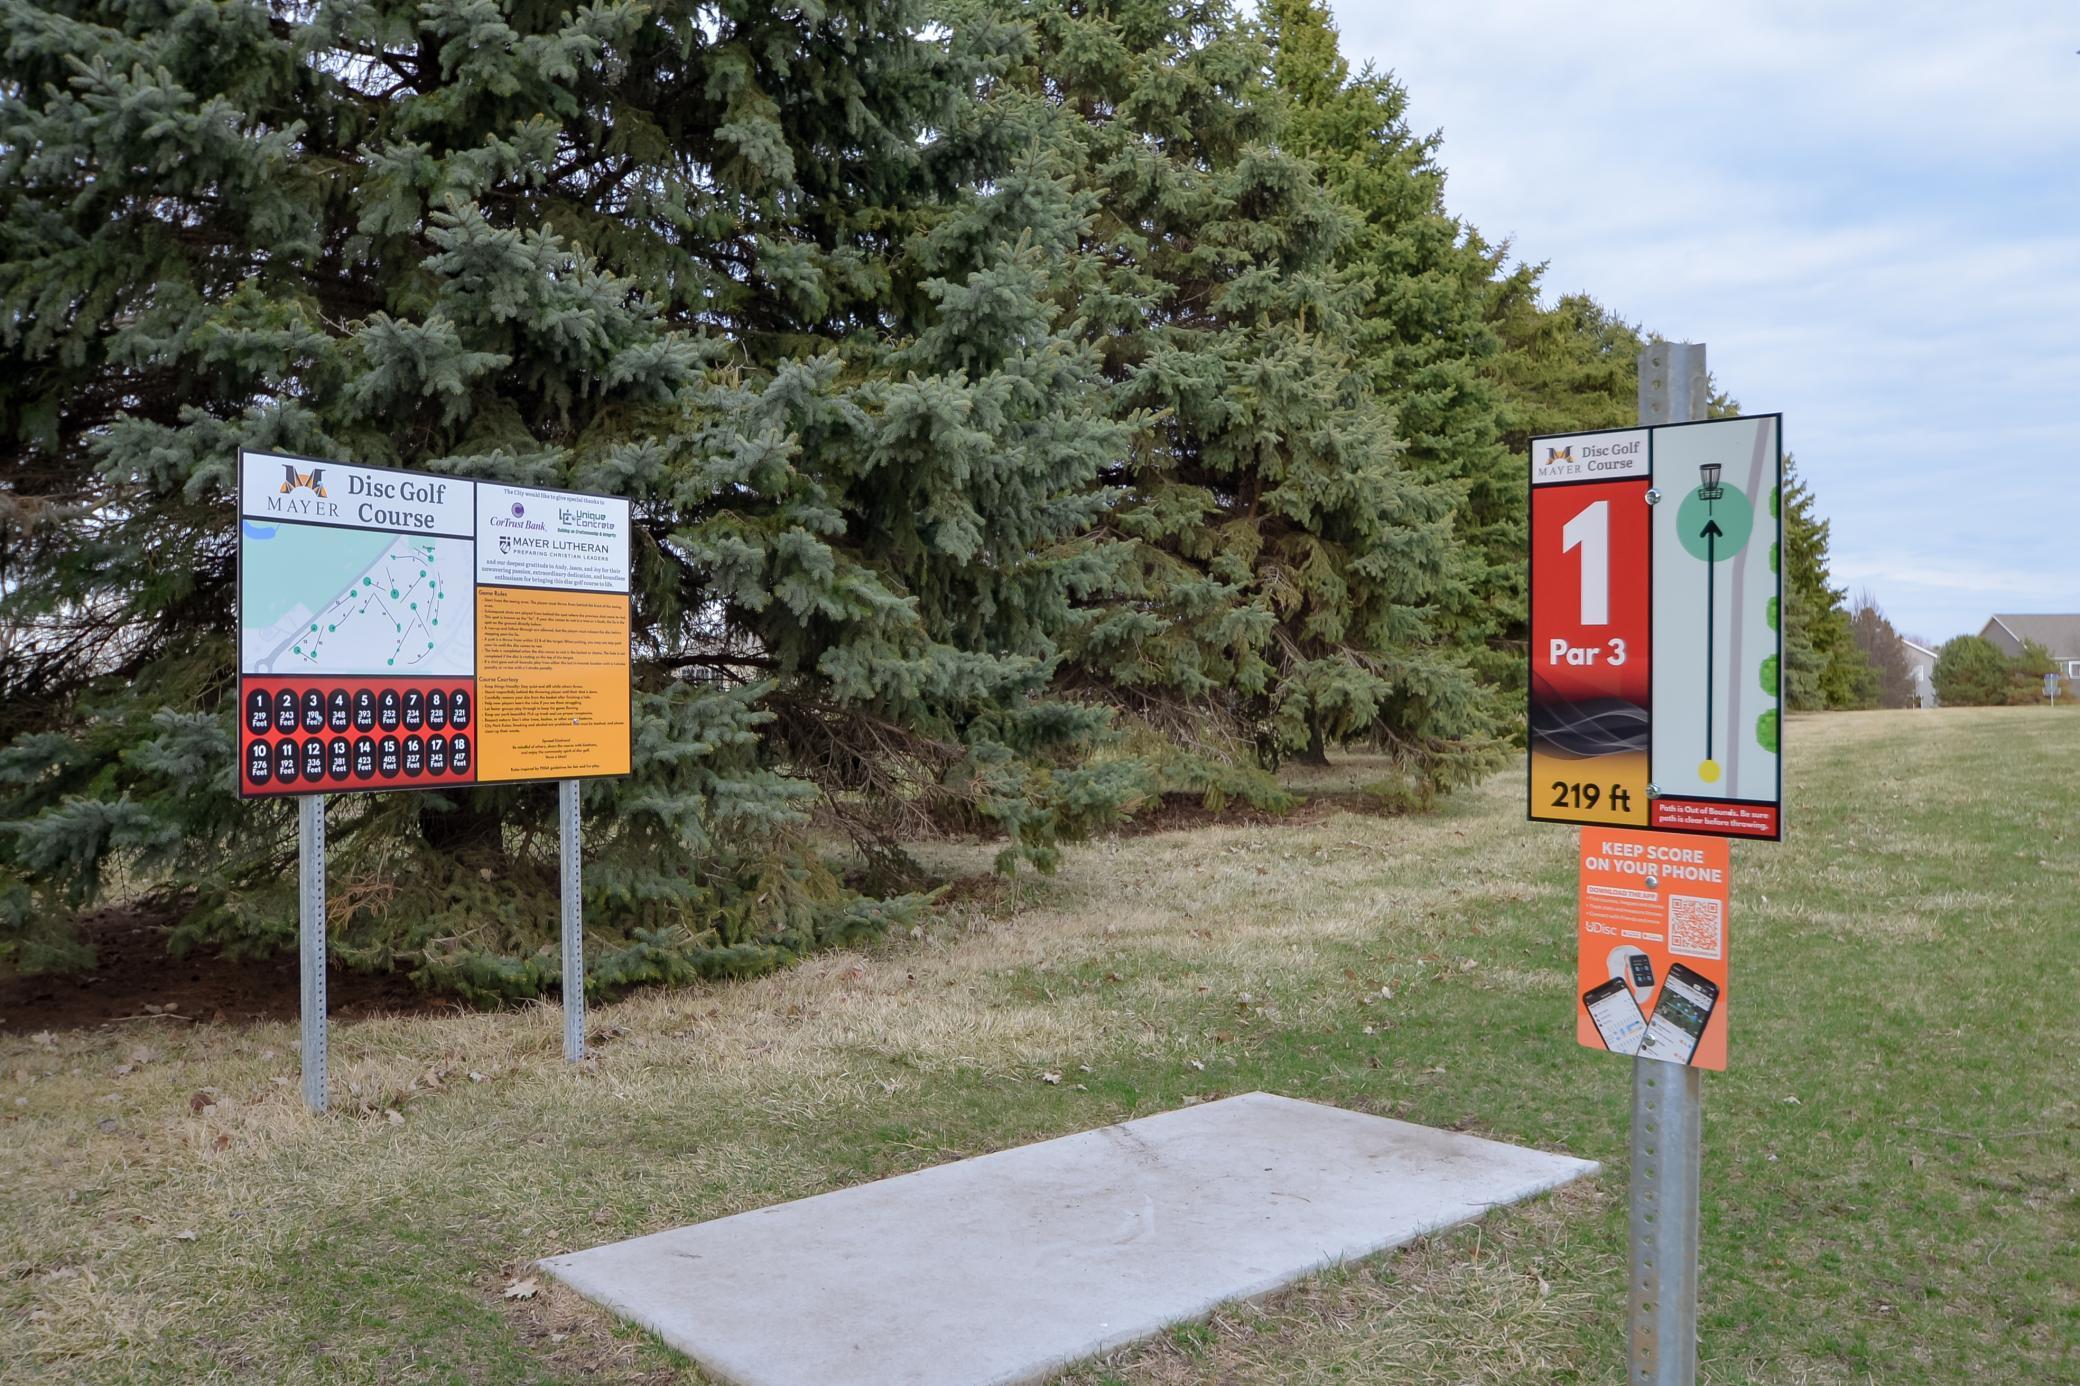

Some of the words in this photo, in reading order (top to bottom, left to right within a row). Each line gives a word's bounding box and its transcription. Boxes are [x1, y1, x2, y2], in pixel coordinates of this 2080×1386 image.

[1582, 446, 1609, 458] Disc
[1611, 441, 1640, 456] Golf
[1538, 464, 1582, 476] MAYER
[1587, 458, 1633, 472] Course
[348, 474, 396, 498] Disc
[400, 481, 446, 504] Golf
[514, 489, 524, 497] City
[267, 496, 340, 517] MAYER
[358, 502, 435, 529] Course
[576, 509, 606, 521] Unique
[490, 516, 524, 529] CorTrust
[525, 519, 545, 531] Bank
[576, 519, 615, 530] Concrete
[513, 537, 550, 549] MAYER
[552, 540, 609, 554] LUTHERAN
[513, 549, 548, 557] PREPARING
[549, 552, 582, 560] CHRISTIAN
[1562, 500, 1609, 626] 1
[1549, 638, 1600, 666] Par
[1607, 638, 1626, 666] 3
[256, 694, 262, 707] 1
[282, 694, 292, 707] 2
[309, 694, 318, 707] 3
[334, 694, 344, 707] 4
[360, 694, 369, 706] 5
[385, 694, 393, 706] 6
[409, 694, 418, 706] 7
[432, 694, 441, 706] 8
[455, 694, 464, 706] 9
[253, 711, 267, 720] 219
[280, 710, 295, 719] 243
[307, 710, 320, 718] 198
[332, 710, 346, 719] 348
[358, 709, 371, 718] 393
[382, 709, 396, 718] 252
[406, 709, 420, 717] 234
[453, 708, 466, 717] 321
[252, 719, 268, 727] Feet
[279, 718, 295, 726] Feet
[332, 718, 347, 726] Feet
[357, 717, 372, 725] Feet
[406, 716, 420, 724] Feet
[282, 743, 292, 756] 11
[307, 742, 321, 755] 12
[333, 742, 346, 754] 13
[358, 741, 371, 754] 14
[383, 740, 395, 753] 15
[407, 739, 419, 752] 16
[431, 739, 443, 751] 17
[454, 738, 466, 750] 18
[253, 744, 267, 757] 10
[454, 752, 466, 760] 417
[307, 758, 321, 767] 336
[332, 757, 346, 766] 381
[357, 756, 372, 764] 423
[383, 755, 397, 763] 405
[406, 754, 420, 762] 327
[430, 753, 443, 761] 342
[252, 760, 268, 769] 276
[280, 759, 294, 768] 192
[357, 763, 372, 771] Feet
[382, 762, 397, 770] Feet
[406, 761, 420, 769] Feet
[430, 760, 444, 768] Feet
[453, 759, 467, 767] Feet
[252, 768, 268, 776] Feet
[279, 767, 295, 775] Feet
[306, 766, 322, 774] Feet
[1550, 781, 1600, 810] 219
[1608, 784, 1631, 813] ft
[1659, 804, 1676, 812] Path
[1684, 806, 1699, 814] Out
[1708, 808, 1739, 816] Bounds.
[1740, 810, 1750, 818] Be
[1659, 815, 1676, 823] path
[1684, 816, 1703, 824] clear
[1704, 817, 1730, 826] before
[1730, 820, 1769, 831] throwing.
[1602, 842, 1644, 858] KEEP
[1646, 846, 1704, 864] SCORE
[1585, 856, 1610, 871] ON
[1613, 859, 1658, 876] YOUR
[1662, 864, 1722, 883] PHONE
[1588, 886, 1627, 896] DOWNLOAD
